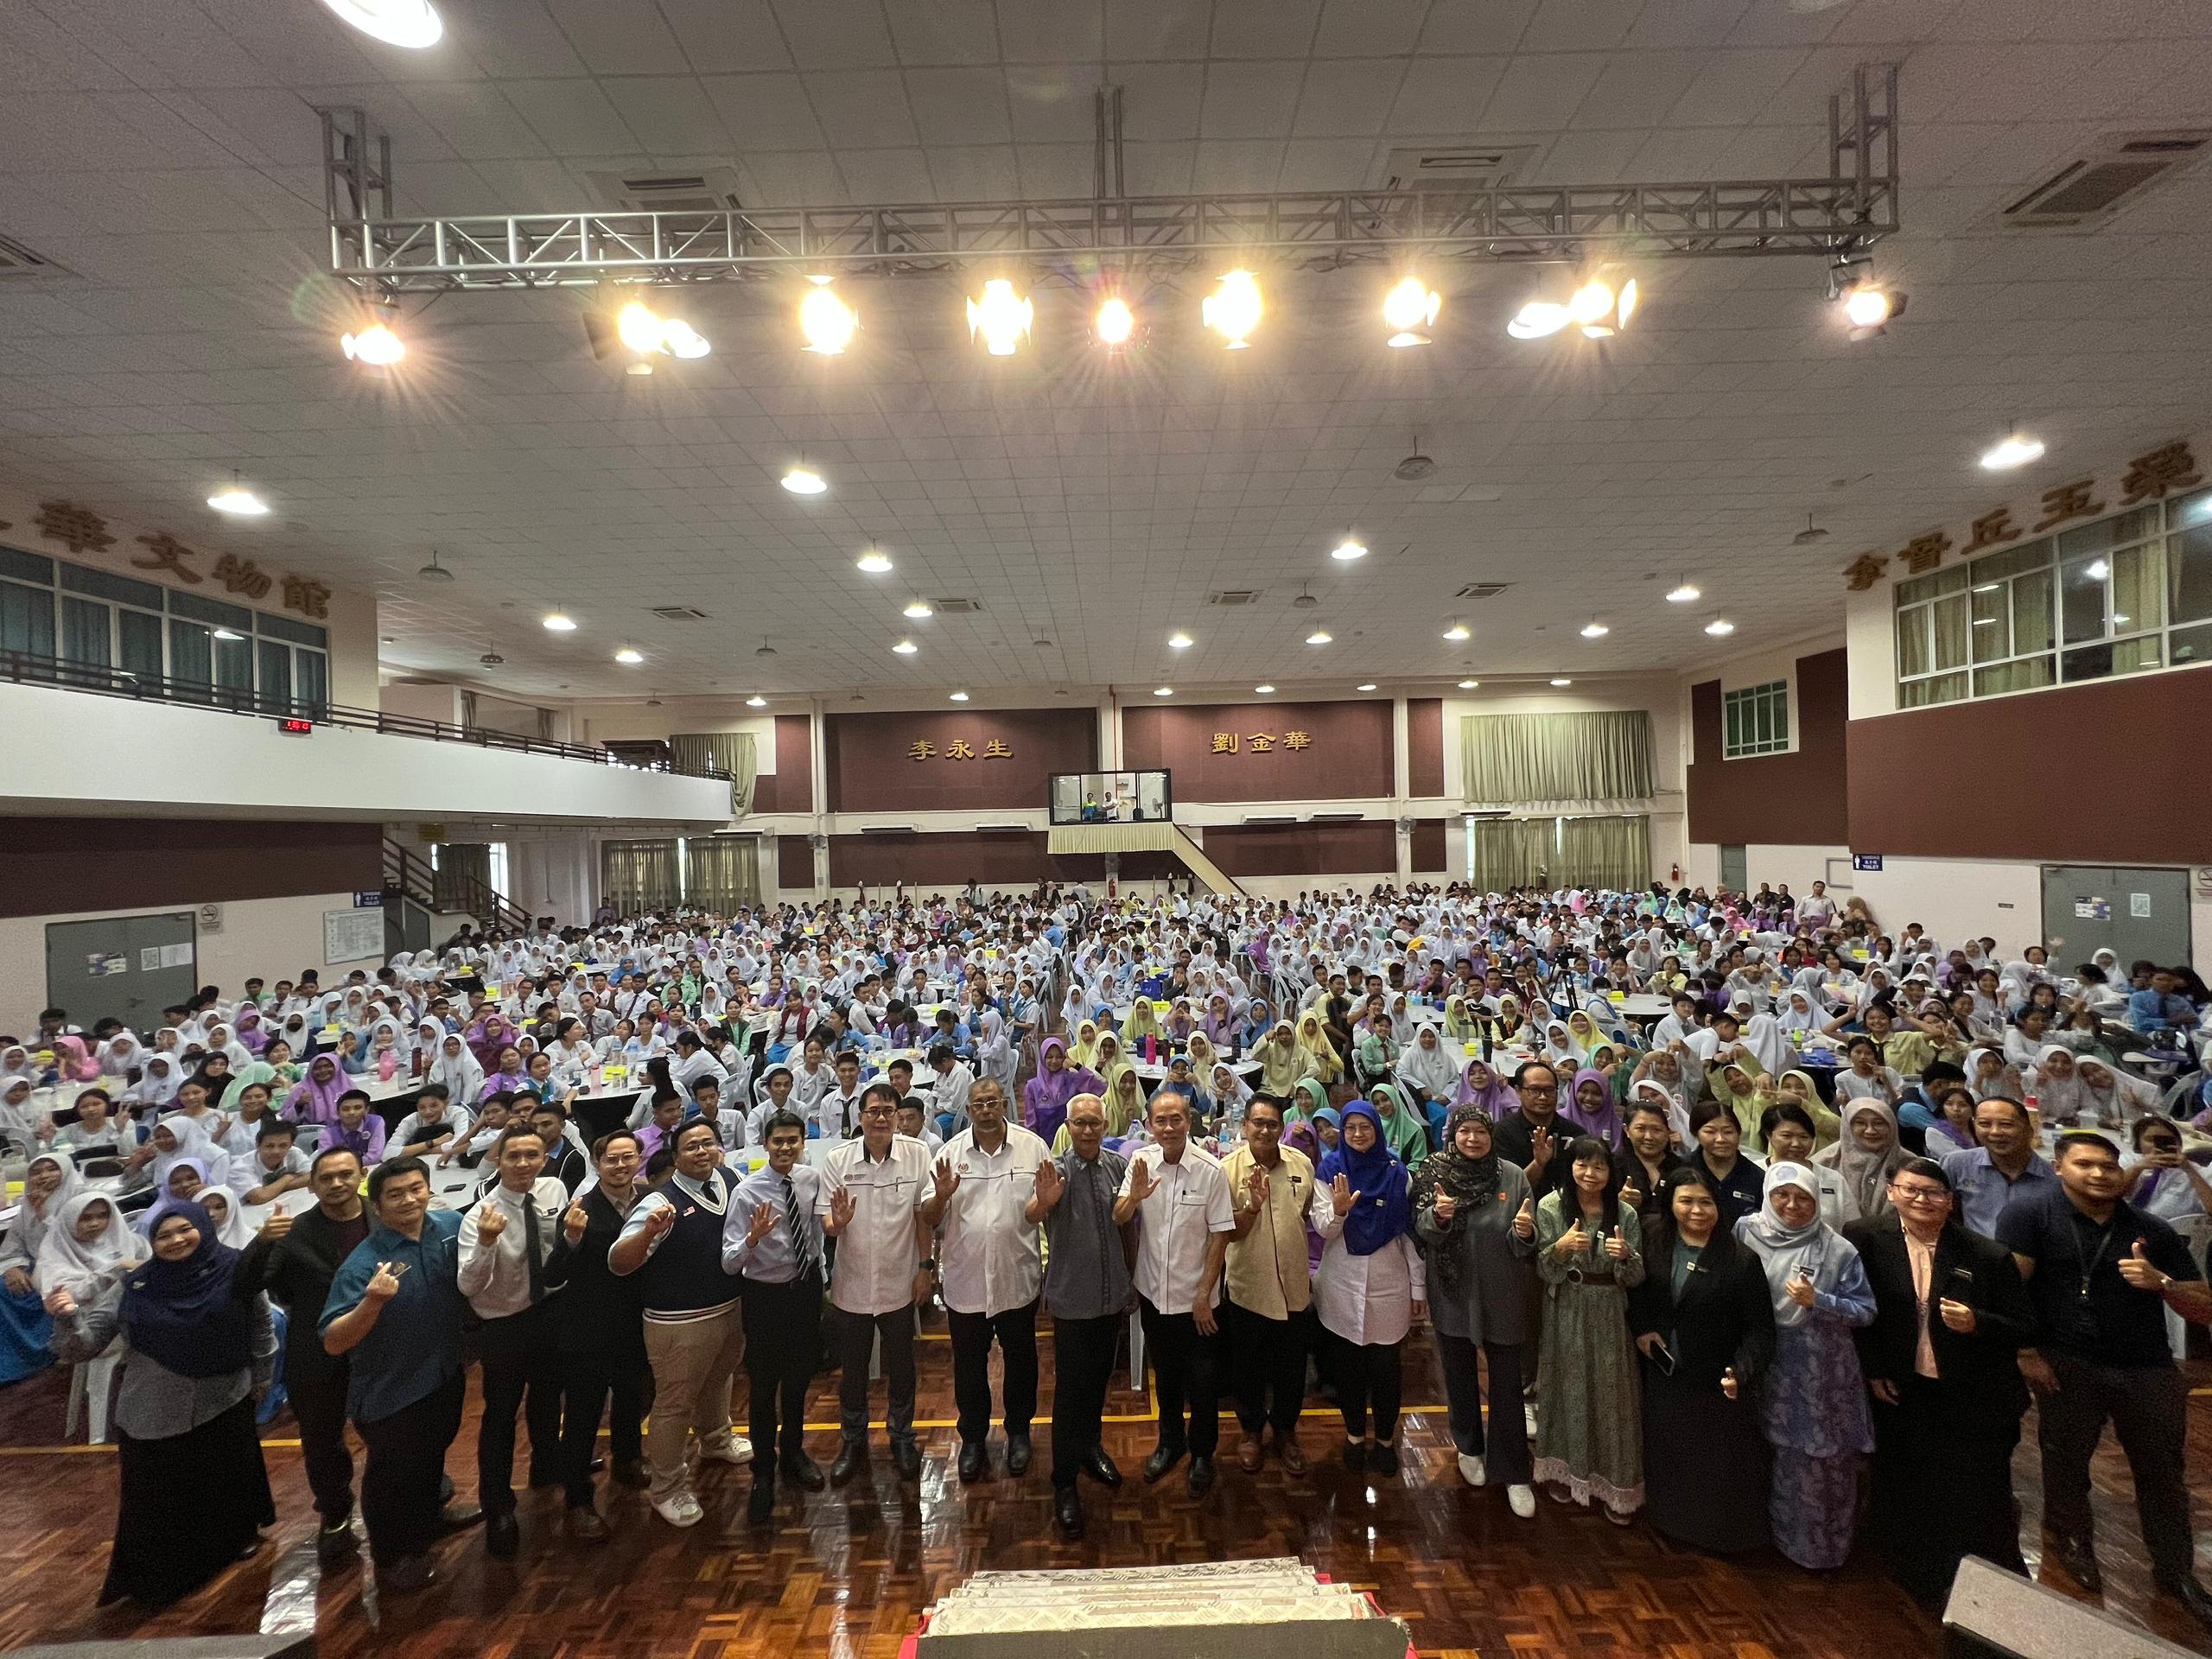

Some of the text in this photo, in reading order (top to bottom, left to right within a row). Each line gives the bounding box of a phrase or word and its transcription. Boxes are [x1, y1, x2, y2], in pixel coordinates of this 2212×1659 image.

[0, 499, 332, 620] 華文物館
[907, 738, 1014, 761] 李永生
[1211, 730, 1312, 754] 劉金華
